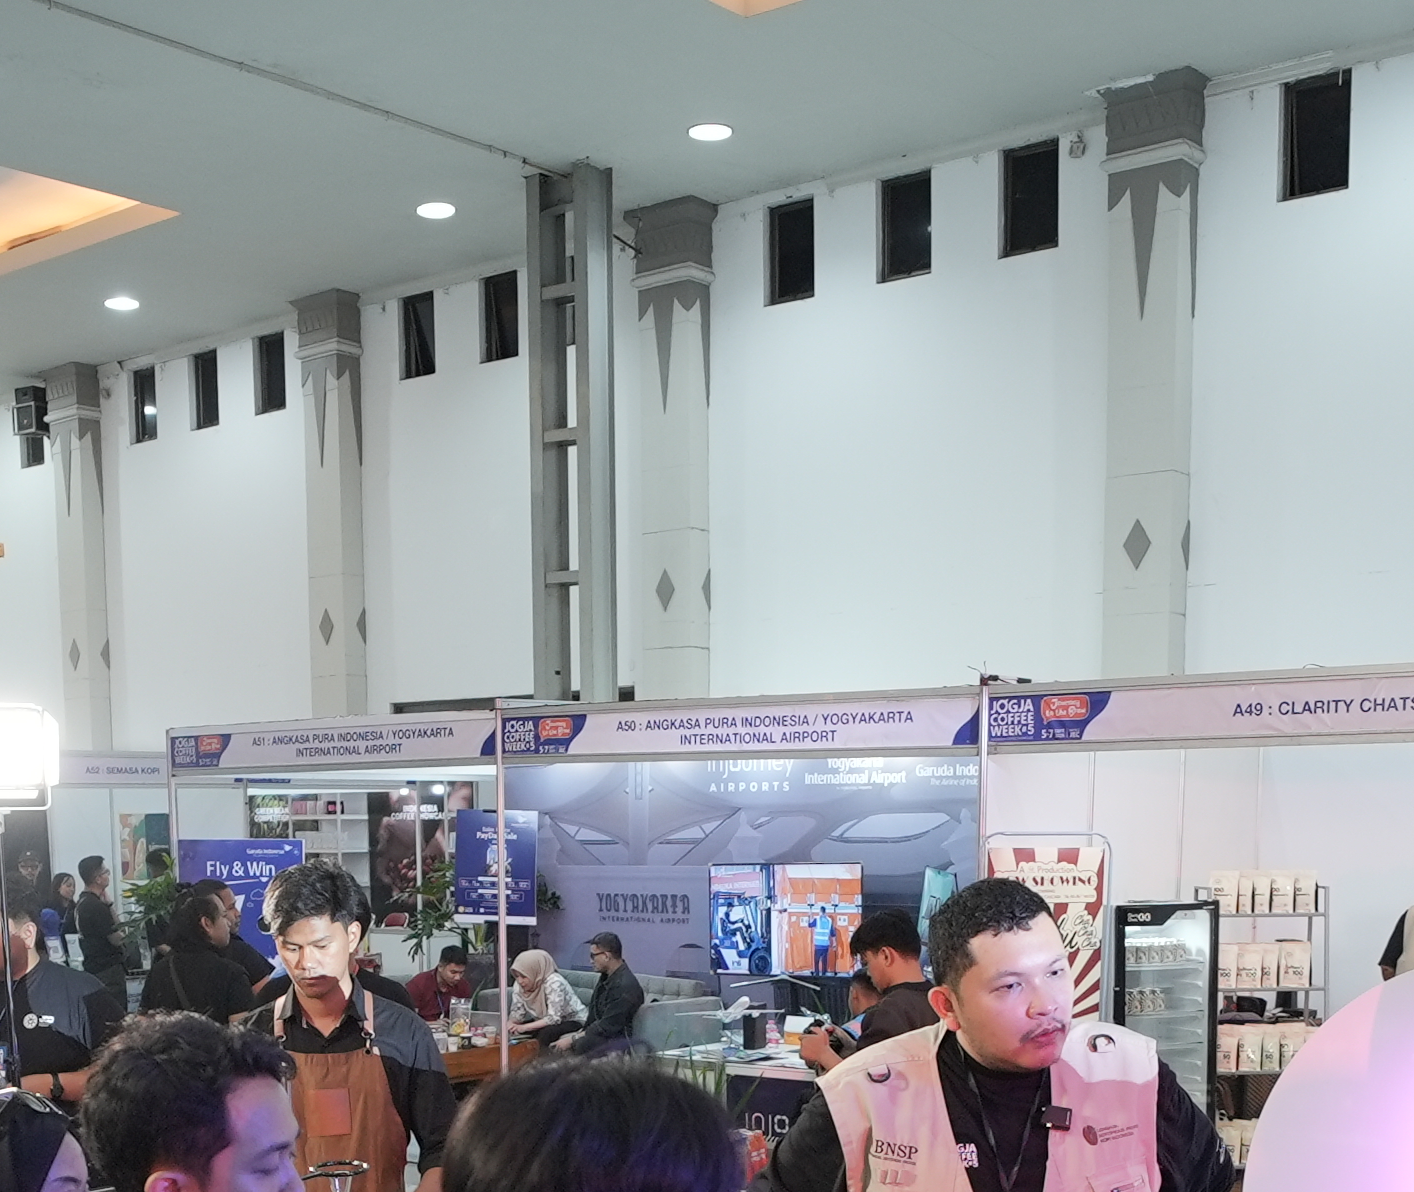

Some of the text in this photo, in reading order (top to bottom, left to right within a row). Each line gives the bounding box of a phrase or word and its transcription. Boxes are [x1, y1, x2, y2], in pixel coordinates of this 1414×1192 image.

[990, 698, 1034, 714] JOGJA
[1232, 702, 1263, 717] A49
[1278, 699, 1354, 716] CLARITY
[616, 720, 637, 732] A50
[645, 717, 701, 731] ANGKASA
[704, 716, 737, 729] PURA
[741, 713, 809, 728] INDONESIA
[822, 710, 914, 726] YOGYAKARTA
[990, 712, 1034, 725] COFFEE
[504, 720, 534, 732] JOGJA
[252, 737, 266, 746] A51
[272, 734, 310, 745] ANGKASA
[312, 733, 336, 744] PURA
[337, 731, 384, 743] INDONESIA
[392, 727, 454, 740] YOGYAKARTA
[504, 732, 535, 742] COFFEE
[680, 730, 837, 746] INTERNATIONAL AIRPORT
[296, 743, 402, 757] INTERNATIONAL AIRPORT
[85, 766, 100, 774] A52
[106, 766, 139, 774] SEMASA
[140, 766, 160, 774] KOPI
[915, 762, 978, 776] Garuda Indo
[805, 770, 907, 785] International Airport
[709, 781, 791, 792] AIRPORTS
[206, 861, 275, 880] Fly & Win
[1032, 875, 1095, 887] SHOWING
[596, 892, 691, 914] YOGYAKARTA
[599, 916, 690, 925] INTERNATIONAL AIRPORT
[874, 1139, 919, 1160] BNSP
[956, 1143, 977, 1154] GJA
